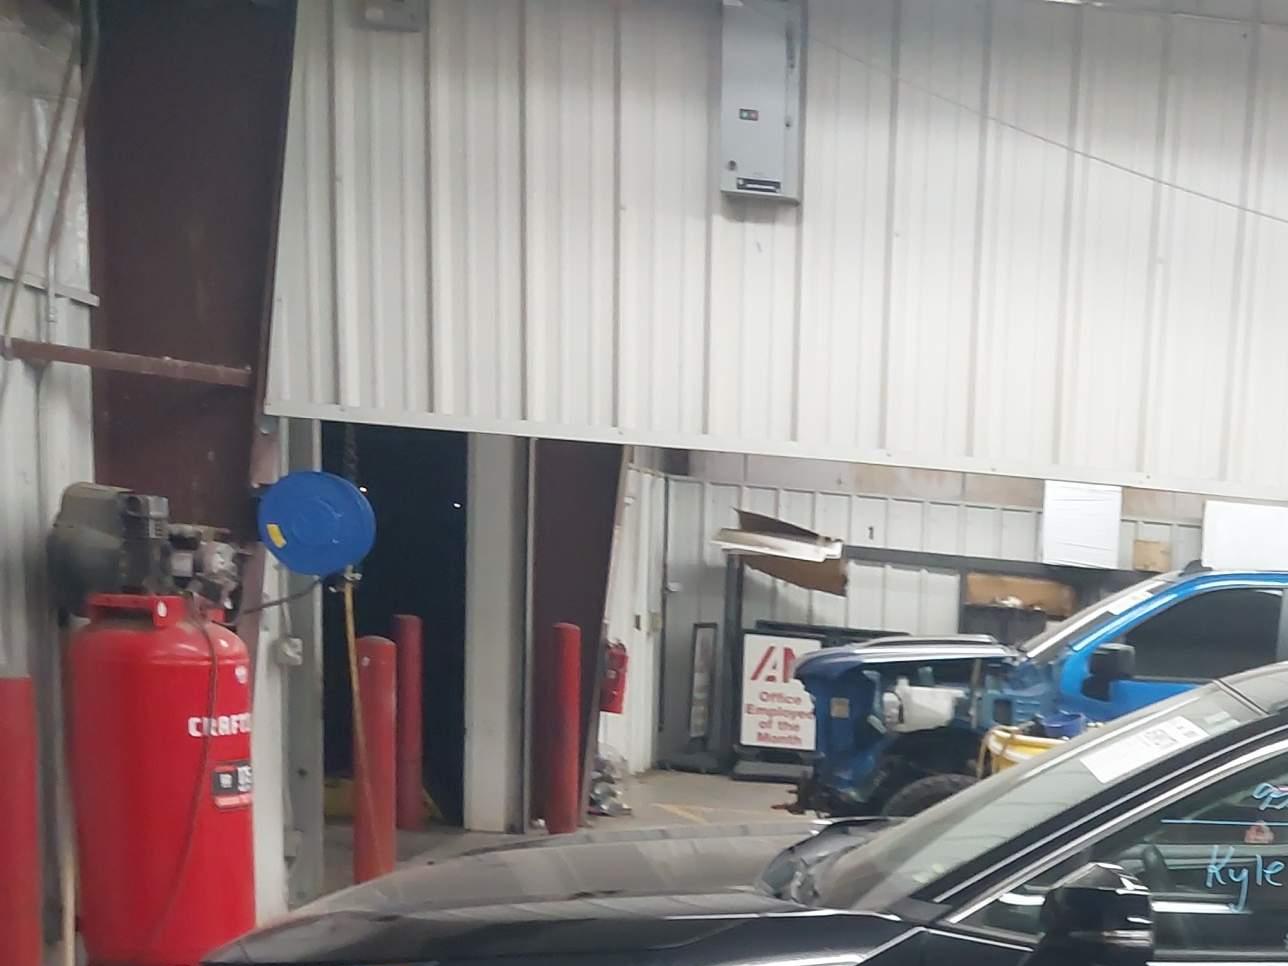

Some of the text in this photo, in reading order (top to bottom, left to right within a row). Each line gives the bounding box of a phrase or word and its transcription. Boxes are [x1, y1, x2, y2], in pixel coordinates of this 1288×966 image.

[760, 691, 802, 705] Office
[758, 716, 800, 731] of the
[756, 732, 802, 745] Month
[1206, 844, 1285, 914] Kyle
